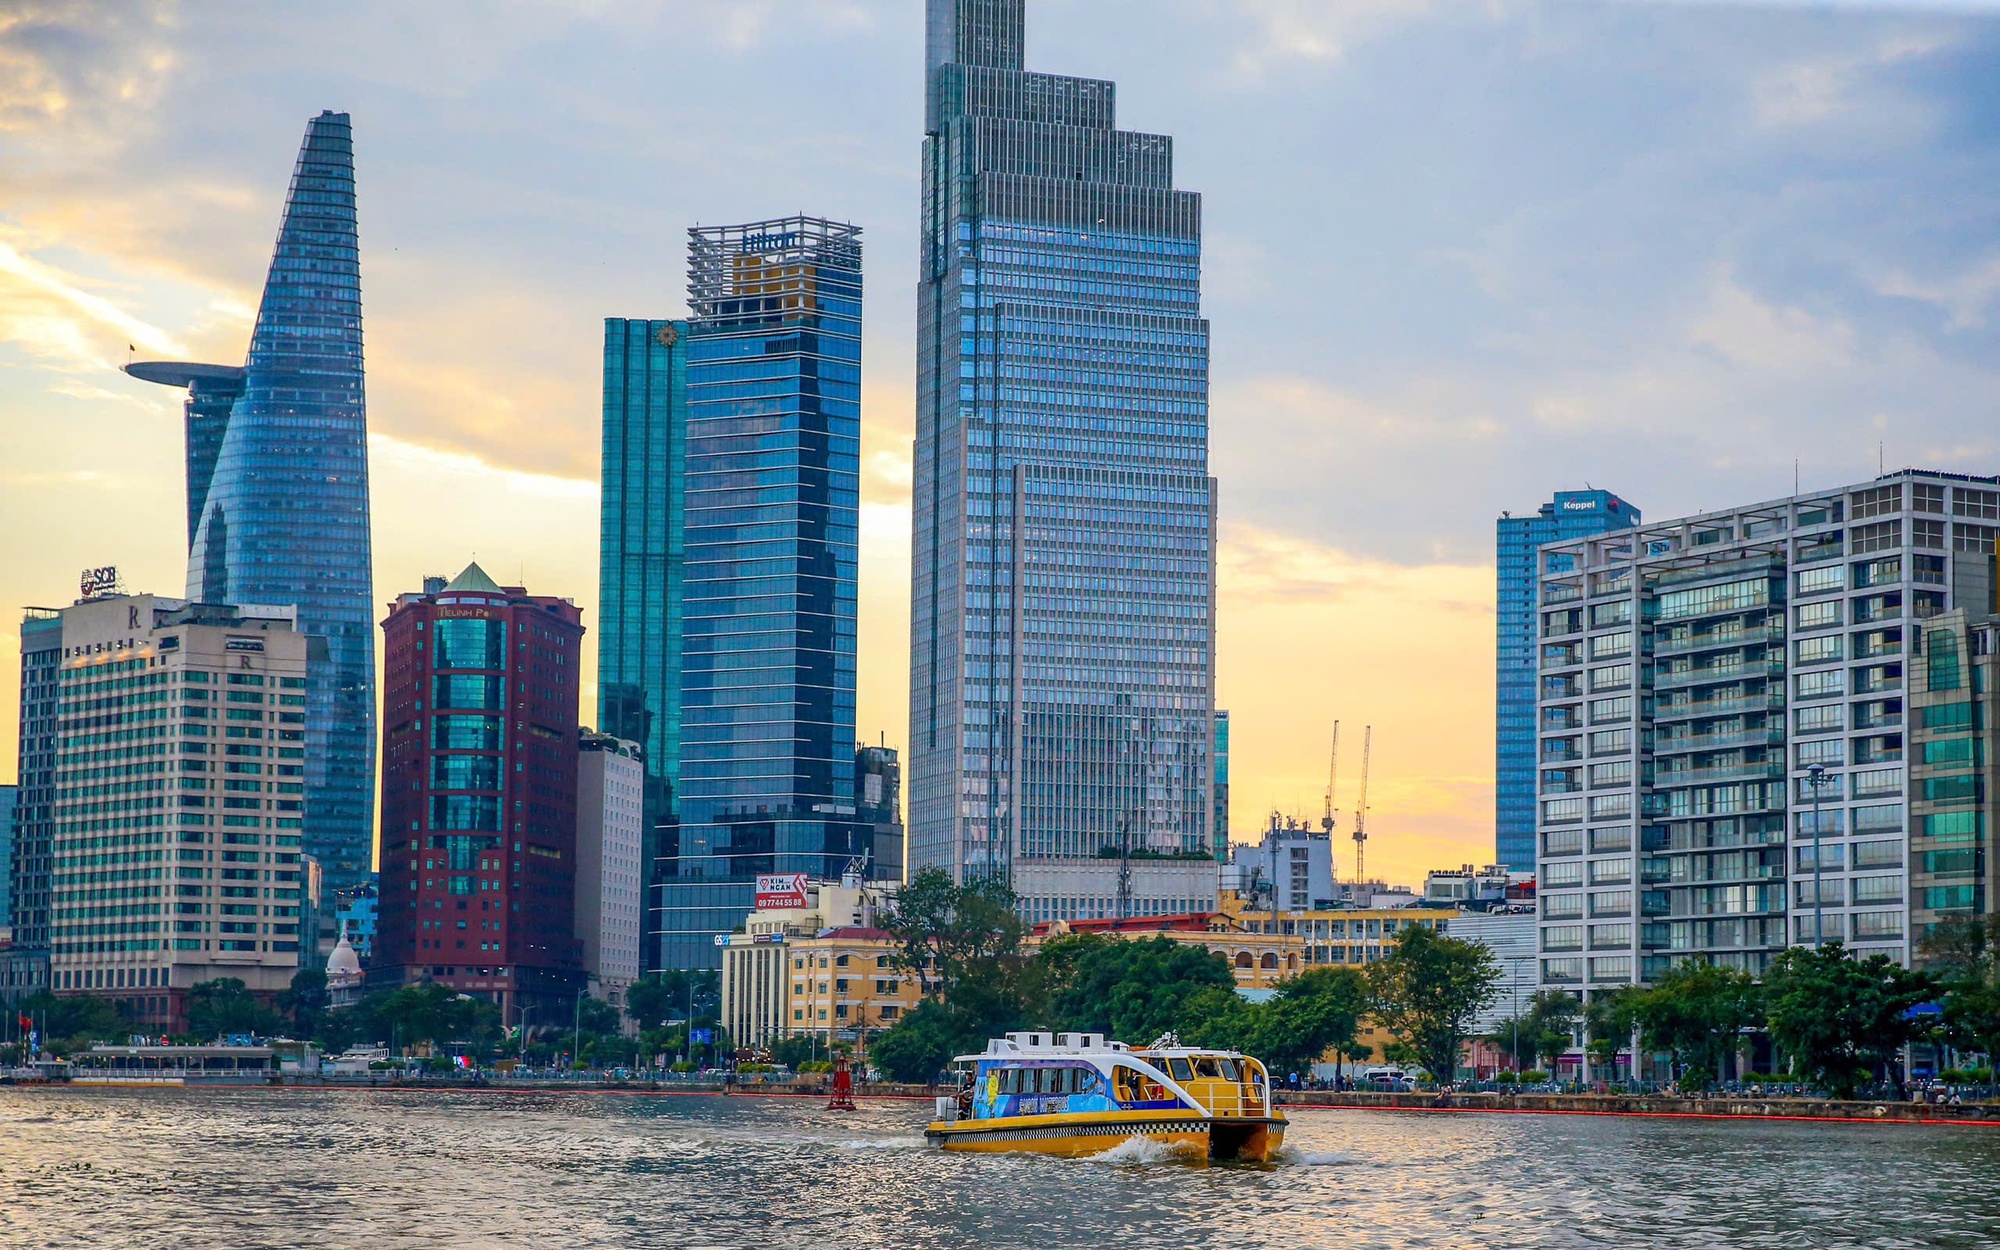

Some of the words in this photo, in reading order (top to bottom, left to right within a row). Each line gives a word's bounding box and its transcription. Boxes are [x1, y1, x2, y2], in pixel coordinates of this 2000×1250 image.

[742, 232, 795, 253] Hilton
[1563, 501, 1596, 510] Keppel
[128, 605, 141, 629] R
[240, 655, 251, 669] R
